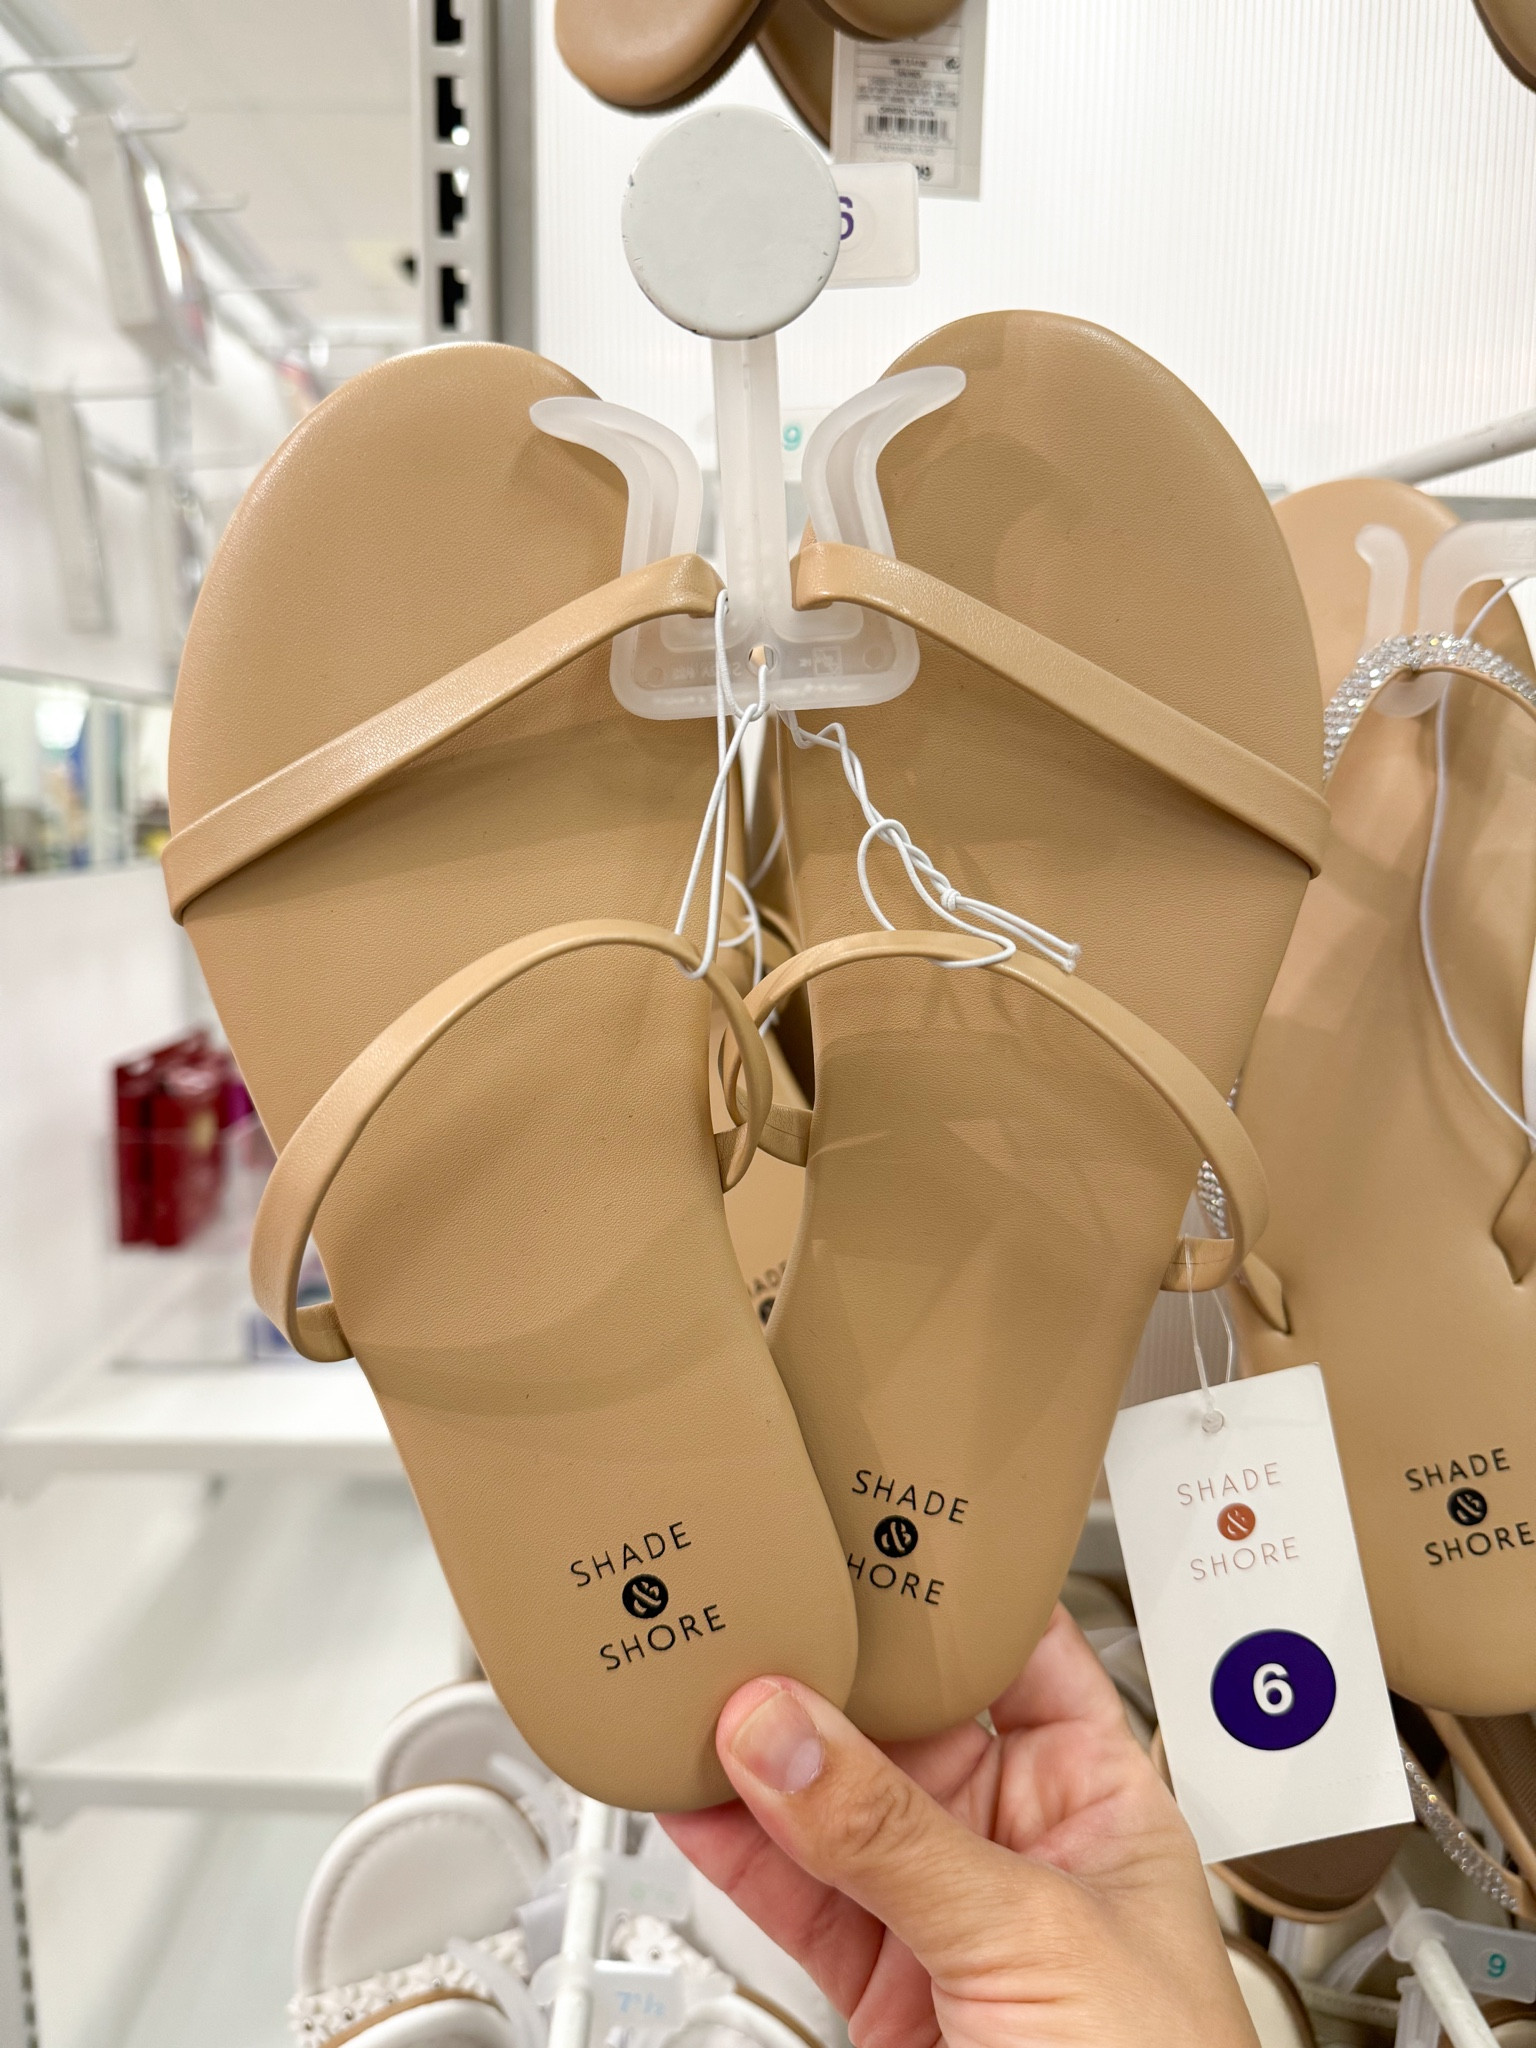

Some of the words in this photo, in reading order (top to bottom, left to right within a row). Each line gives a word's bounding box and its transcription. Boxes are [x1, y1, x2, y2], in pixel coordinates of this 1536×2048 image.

[783, 424, 802, 452] 9
[1176, 1462, 1282, 1506] SHADE
[1405, 1448, 1510, 1491] SHADE
[852, 1469, 969, 1524] SHADE
[570, 1521, 692, 1587] SHADE
[1190, 1537, 1300, 1581] SHORE
[1424, 1522, 1536, 1565] SHORE
[846, 1552, 944, 1605] HORE
[600, 1604, 726, 1671] SHORE
[1252, 1662, 1295, 1717] 6
[1487, 1953, 1507, 1978] 9
